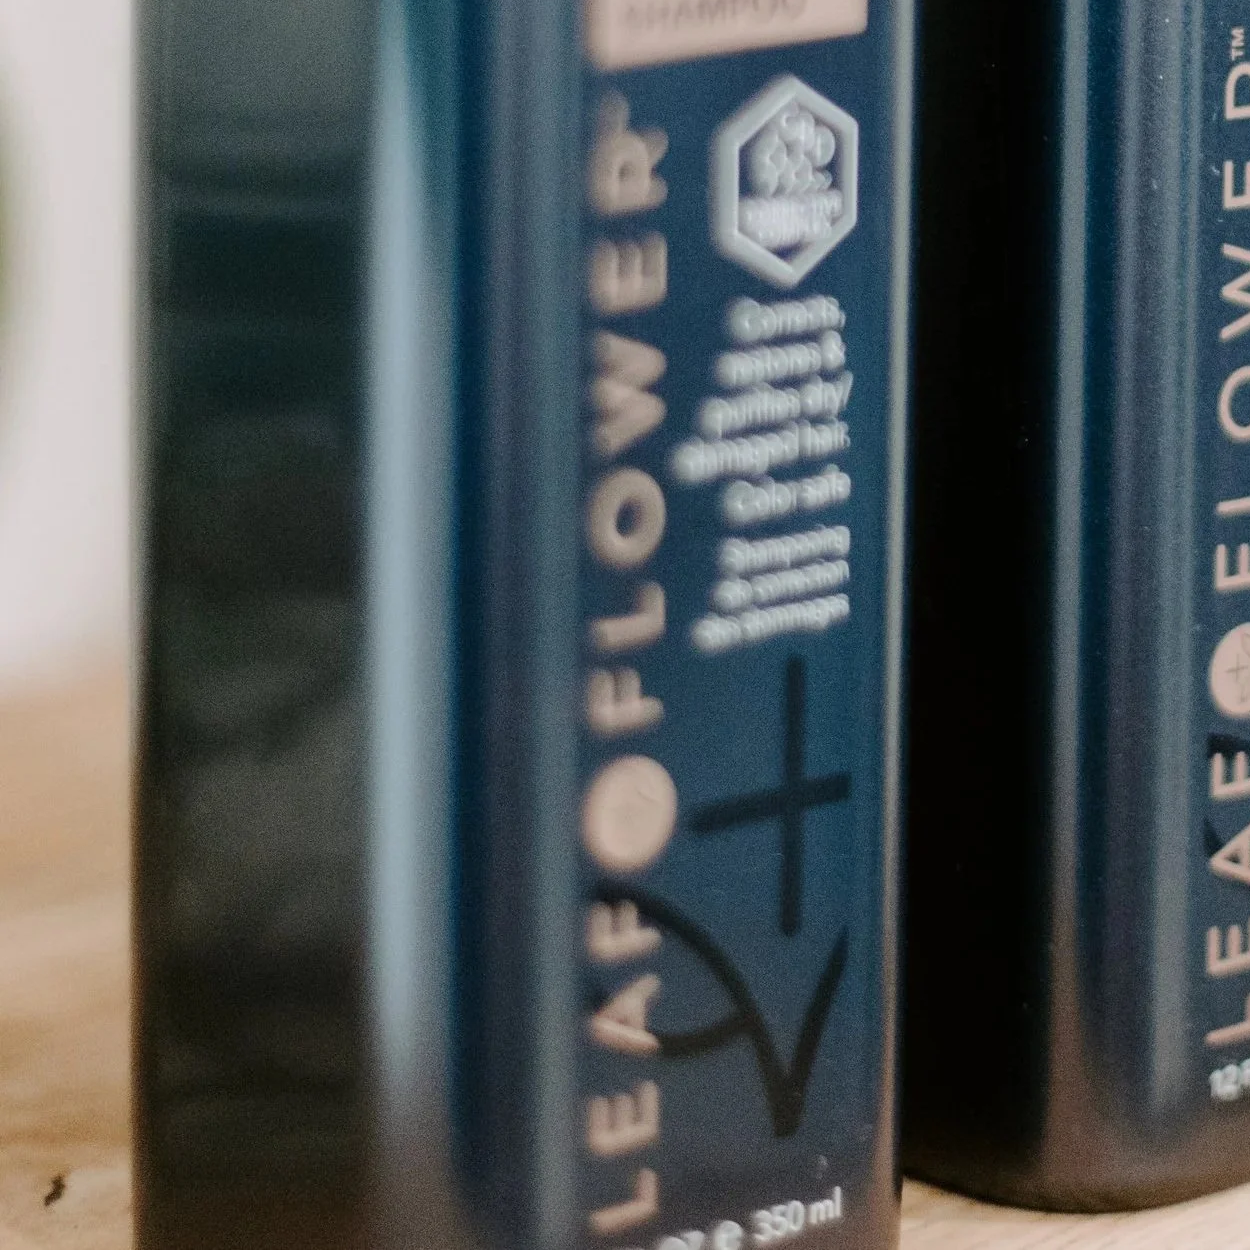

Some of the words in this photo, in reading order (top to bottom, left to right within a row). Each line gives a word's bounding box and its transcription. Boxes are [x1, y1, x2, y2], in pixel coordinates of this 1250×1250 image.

[587, 897, 662, 1234] LEAF
[752, 1199, 806, 1242] 350
[807, 1185, 843, 1225] ml
